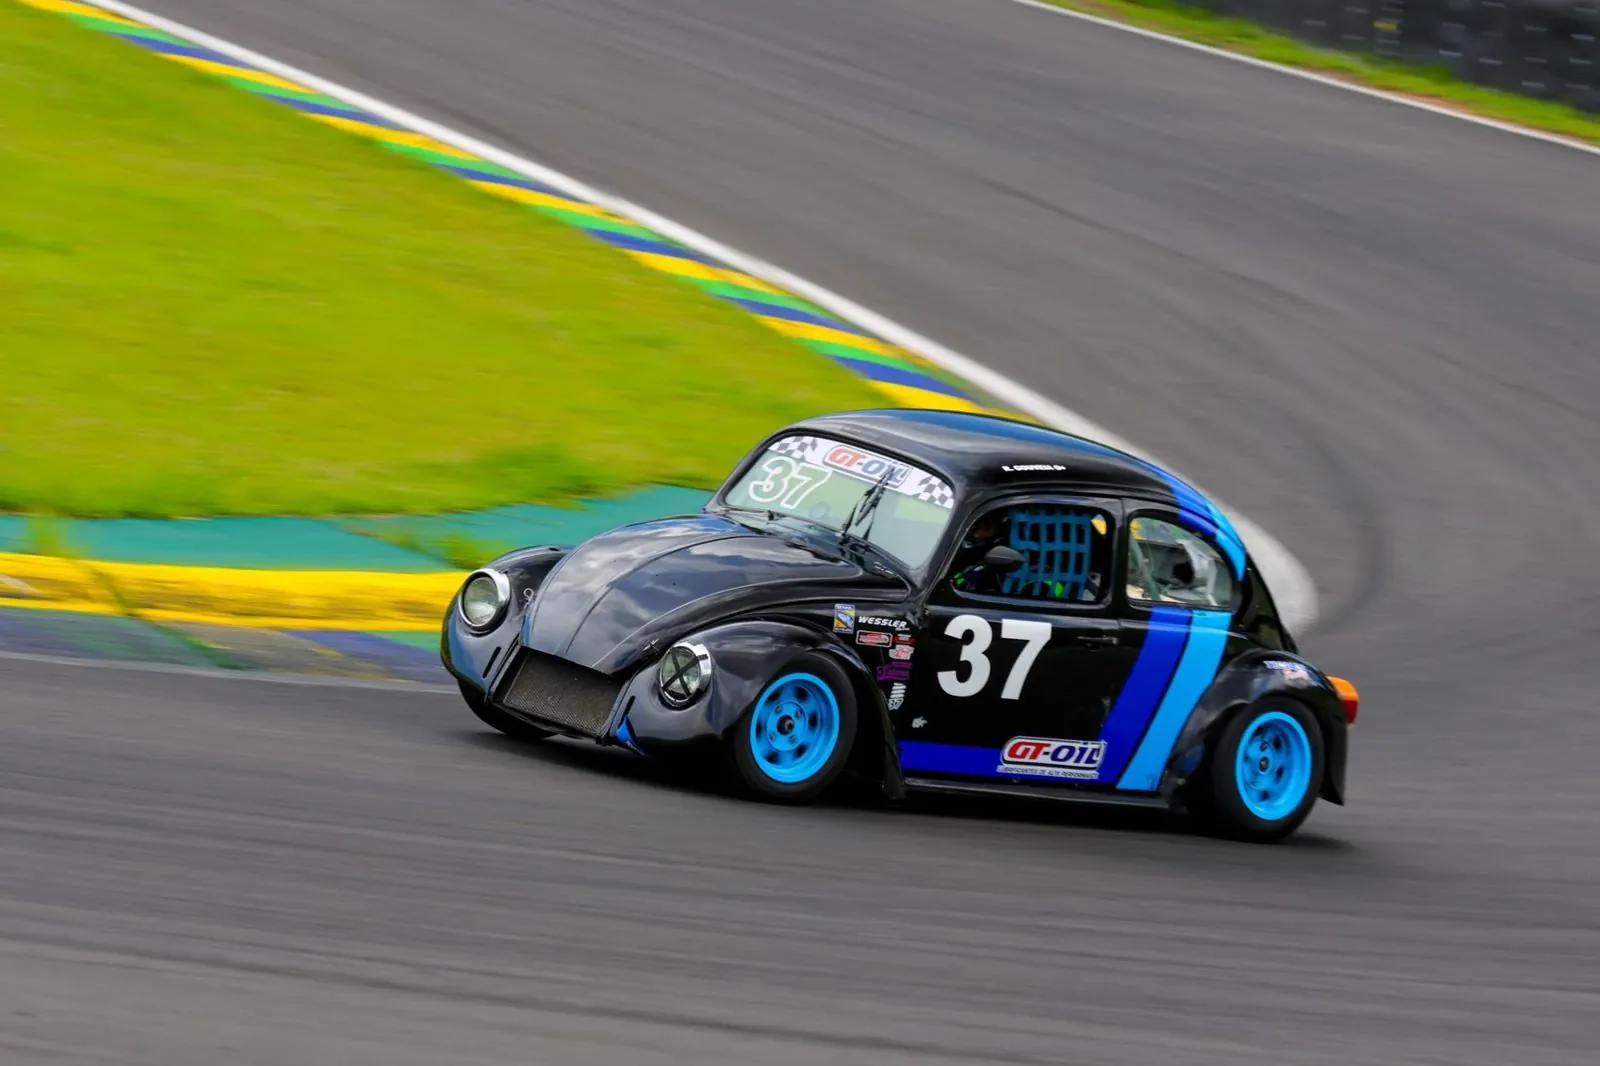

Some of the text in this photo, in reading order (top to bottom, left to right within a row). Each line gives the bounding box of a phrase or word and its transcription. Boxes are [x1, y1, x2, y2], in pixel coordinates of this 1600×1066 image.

[748, 455, 833, 510] 37
[858, 615, 907, 629] WESSLER
[936, 614, 1053, 701] 37
